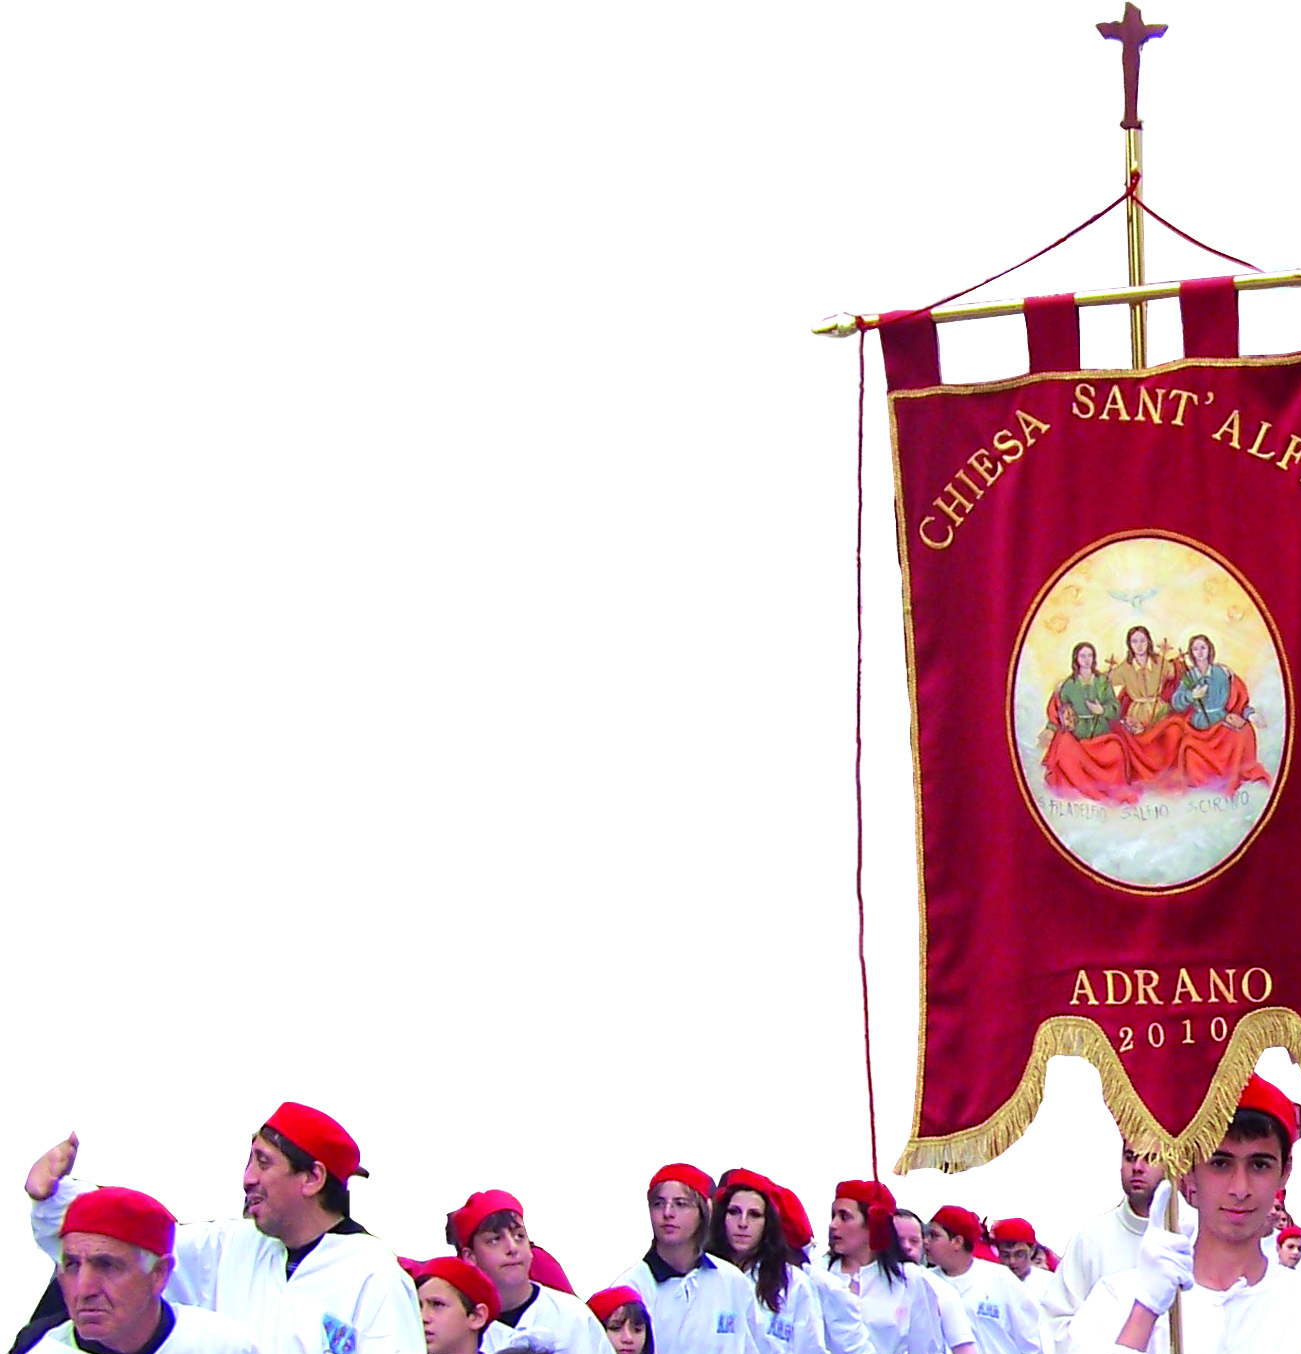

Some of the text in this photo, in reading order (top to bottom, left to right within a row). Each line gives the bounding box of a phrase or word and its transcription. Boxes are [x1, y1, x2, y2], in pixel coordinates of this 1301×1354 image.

[919, 409, 1051, 550] CHIESA
[1069, 967, 1273, 1006] ADRANO
[1119, 1017, 1228, 1053] 2010
